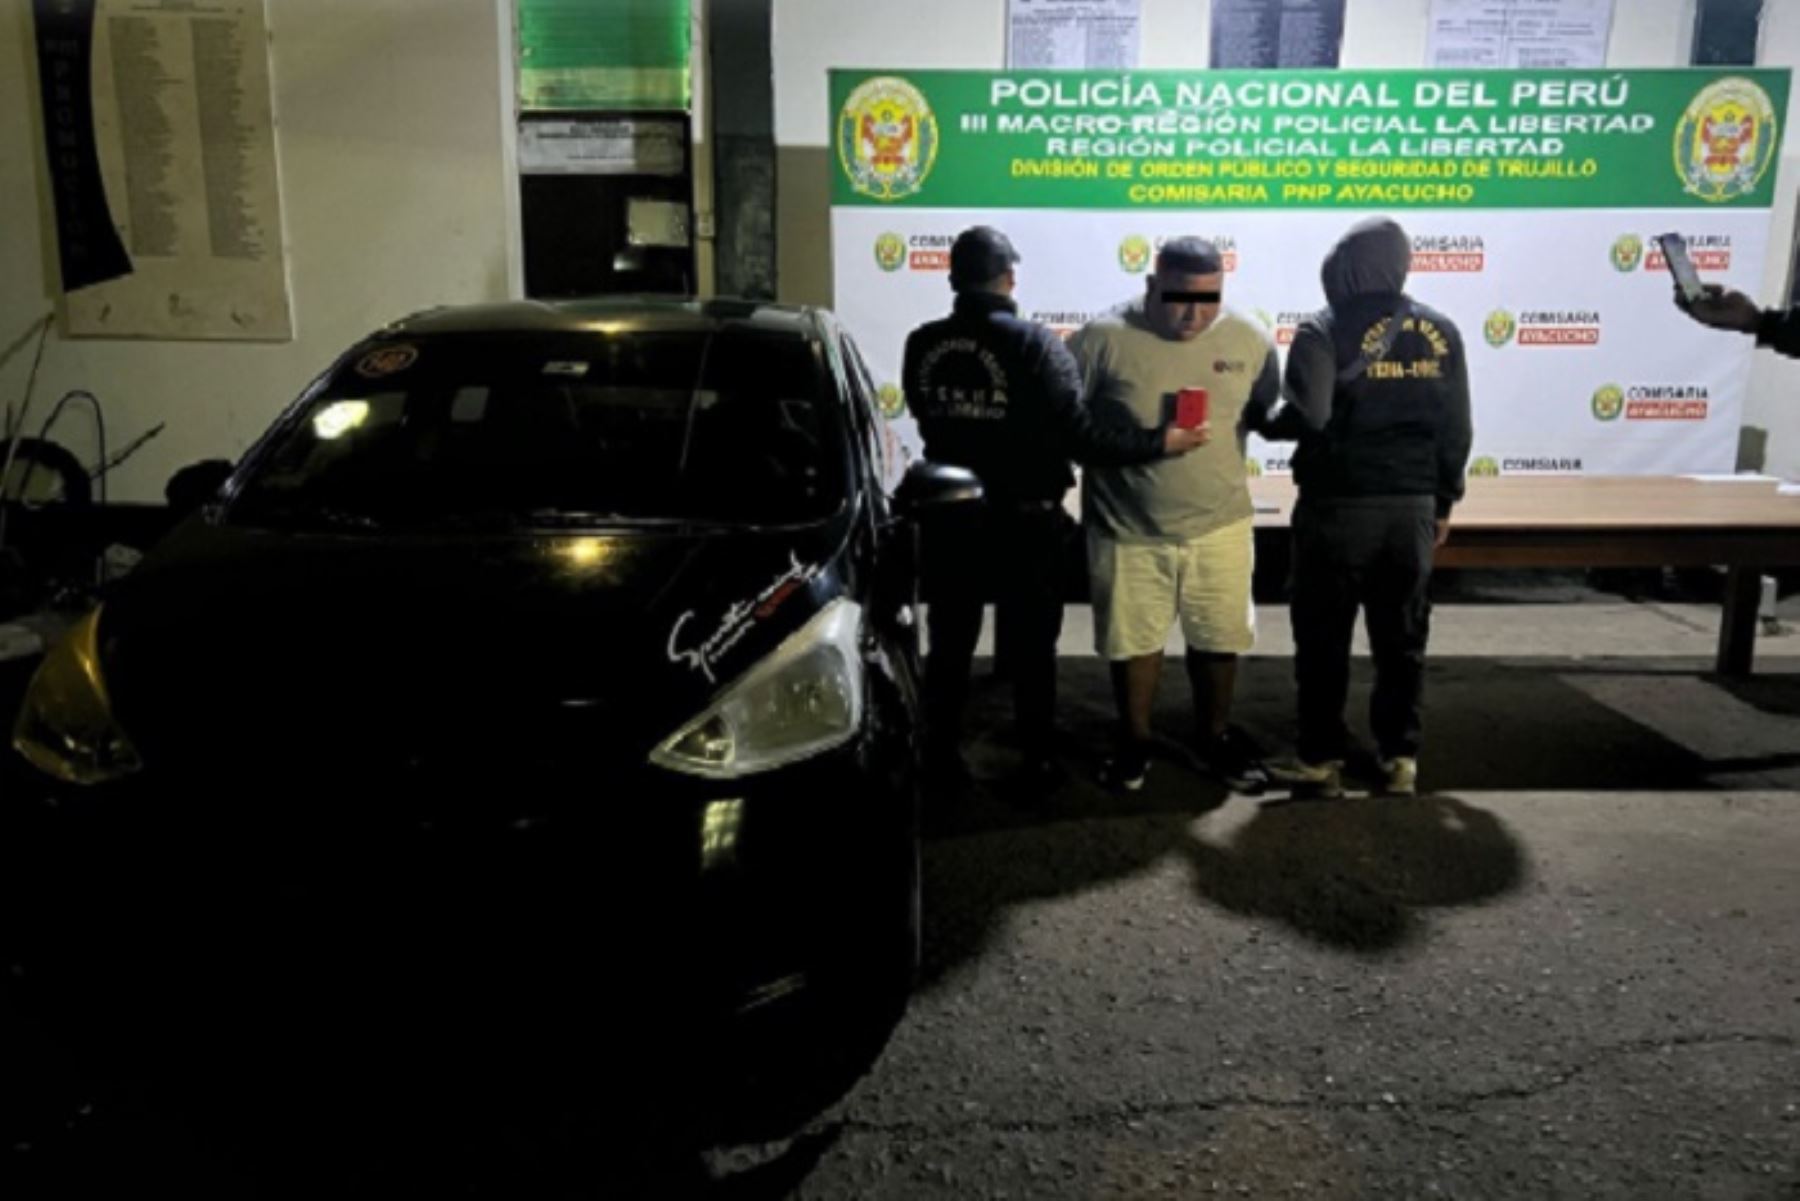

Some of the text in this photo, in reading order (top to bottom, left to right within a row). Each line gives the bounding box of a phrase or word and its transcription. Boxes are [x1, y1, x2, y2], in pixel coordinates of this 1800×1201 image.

[990, 74, 1628, 107] POLICÍA NACIONAL DEL PERÚ
[960, 114, 988, 133] III
[1273, 115, 1427, 134] POLICIAL
[1435, 115, 1480, 134] LA
[1488, 114, 1655, 134] LIBERTAD
[1046, 136, 1565, 157] REGIÓN POLICIAL LA LIBERTAD
[1011, 158, 1099, 178] DIVISIÓN
[1106, 160, 1133, 178] DE
[1140, 160, 1213, 178] ORDEN
[1316, 160, 1330, 178] Y
[1334, 158, 1458, 178] SEGURIDAD
[1461, 159, 1491, 178] DE
[1497, 158, 1597, 178] TRUJILLO
[1128, 183, 1474, 202] COMISARIA PNP AYACUCHO
[1413, 234, 1484, 251] OMISARIA
